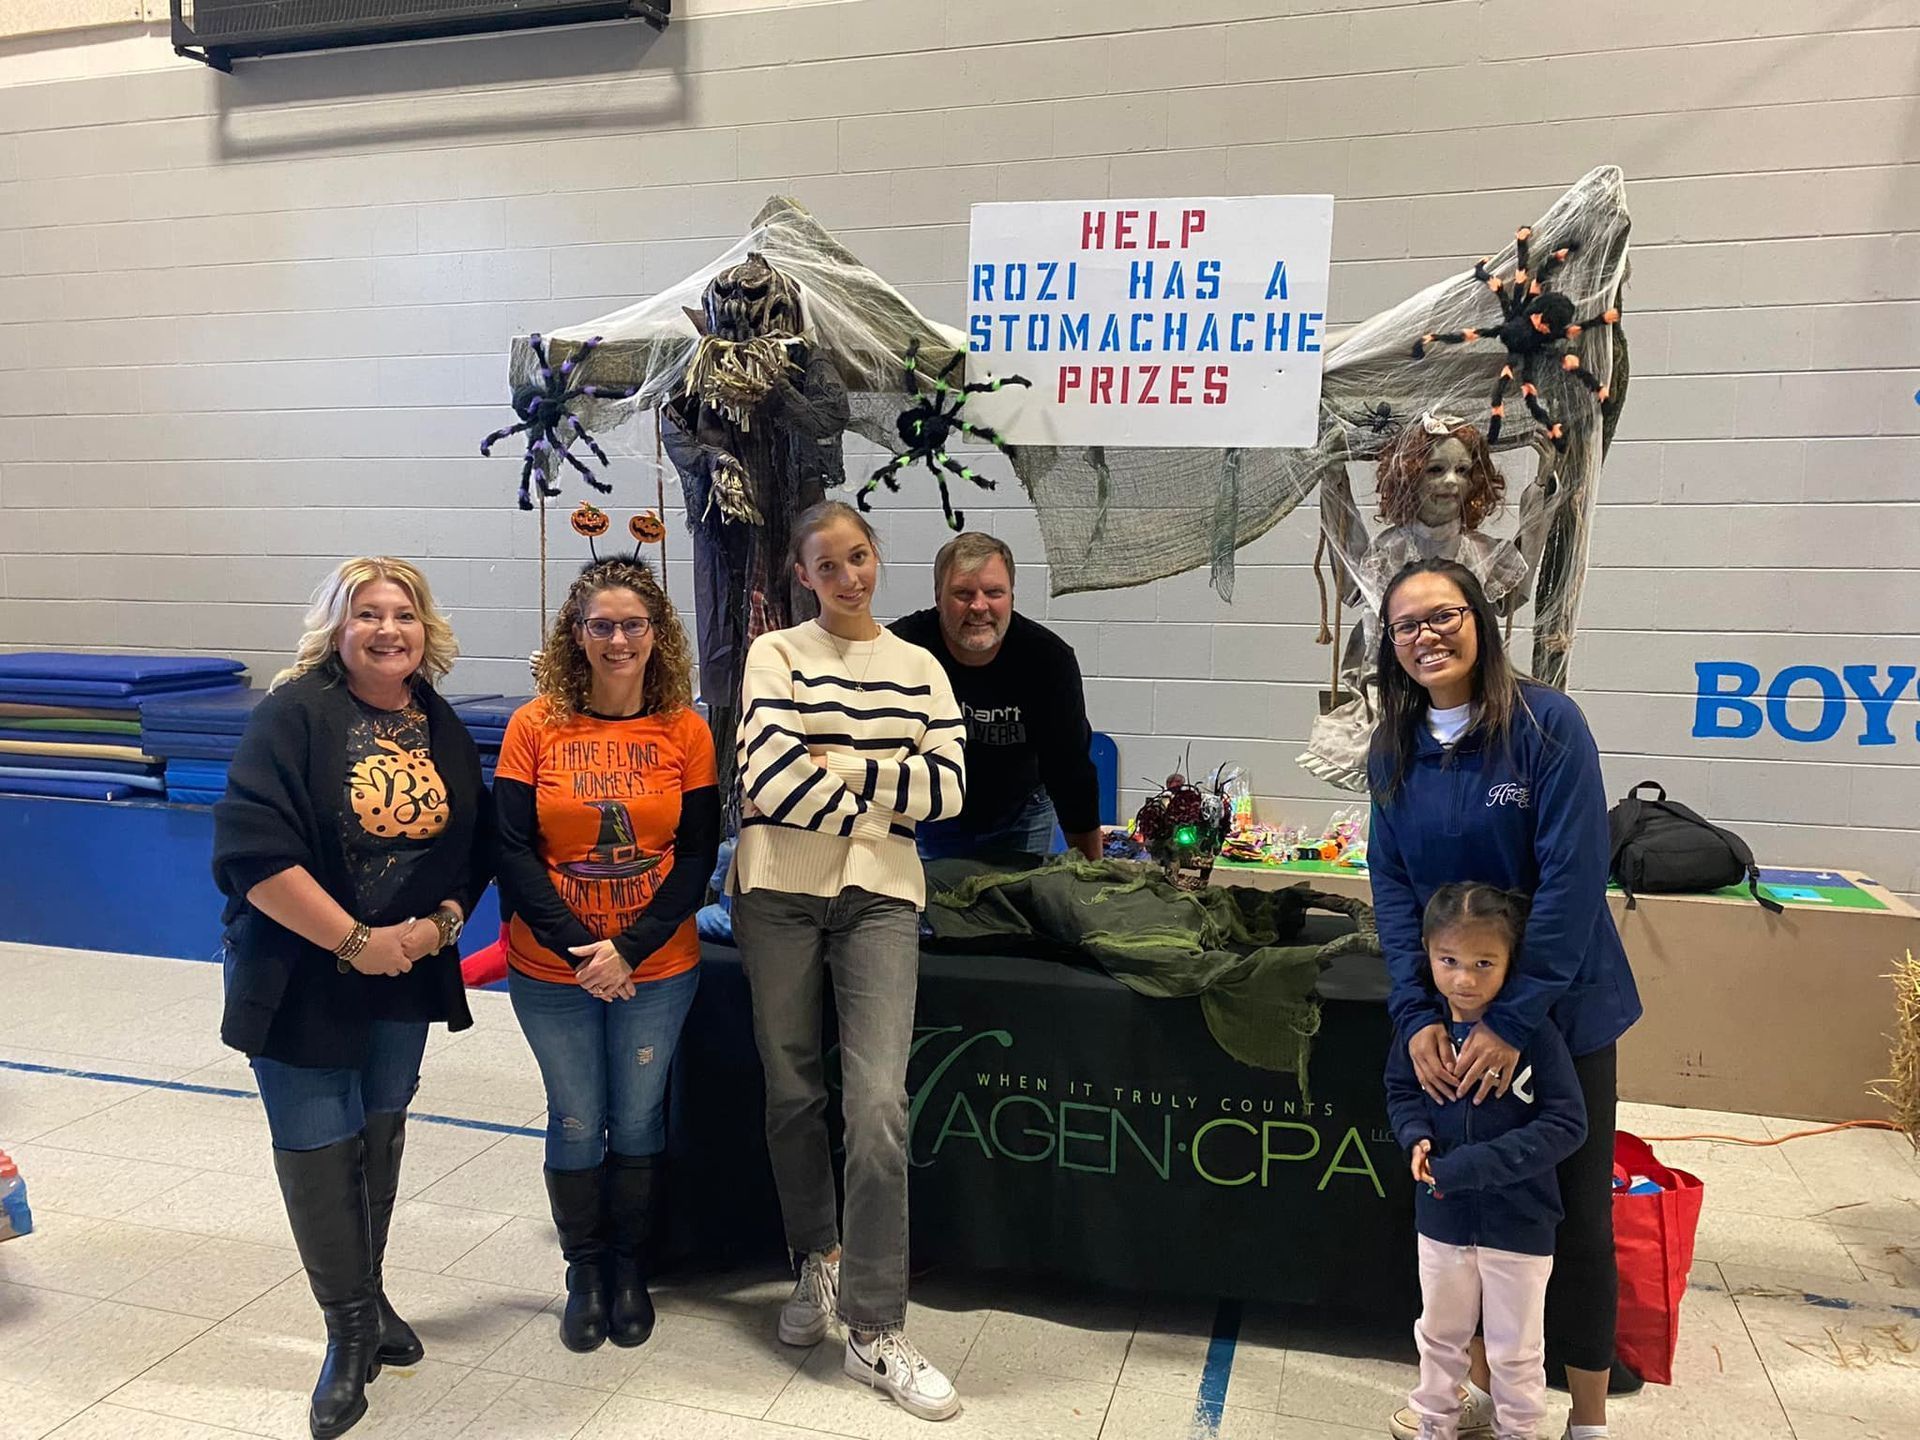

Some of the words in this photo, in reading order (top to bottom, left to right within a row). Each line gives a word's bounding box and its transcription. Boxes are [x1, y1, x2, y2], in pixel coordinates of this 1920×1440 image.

[1081, 209, 1206, 250] HELP
[972, 261, 1077, 302] ROZI
[1129, 260, 1222, 300] HAS
[1265, 260, 1288, 300] A
[969, 312, 1323, 353] STOMACHACHE
[1057, 365, 1229, 405] PRIZES
[1692, 661, 1920, 745] BOY
[551, 742, 557, 771] I
[562, 741, 601, 771] HAVE
[607, 741, 659, 770] FLYING
[609, 872, 651, 909] MAKE
[976, 1072, 1048, 1091] WHEN
[1071, 1082, 1093, 1097] IT
[1114, 1087, 1200, 1110] TRULY
[1220, 1098, 1334, 1117] COUNTS
